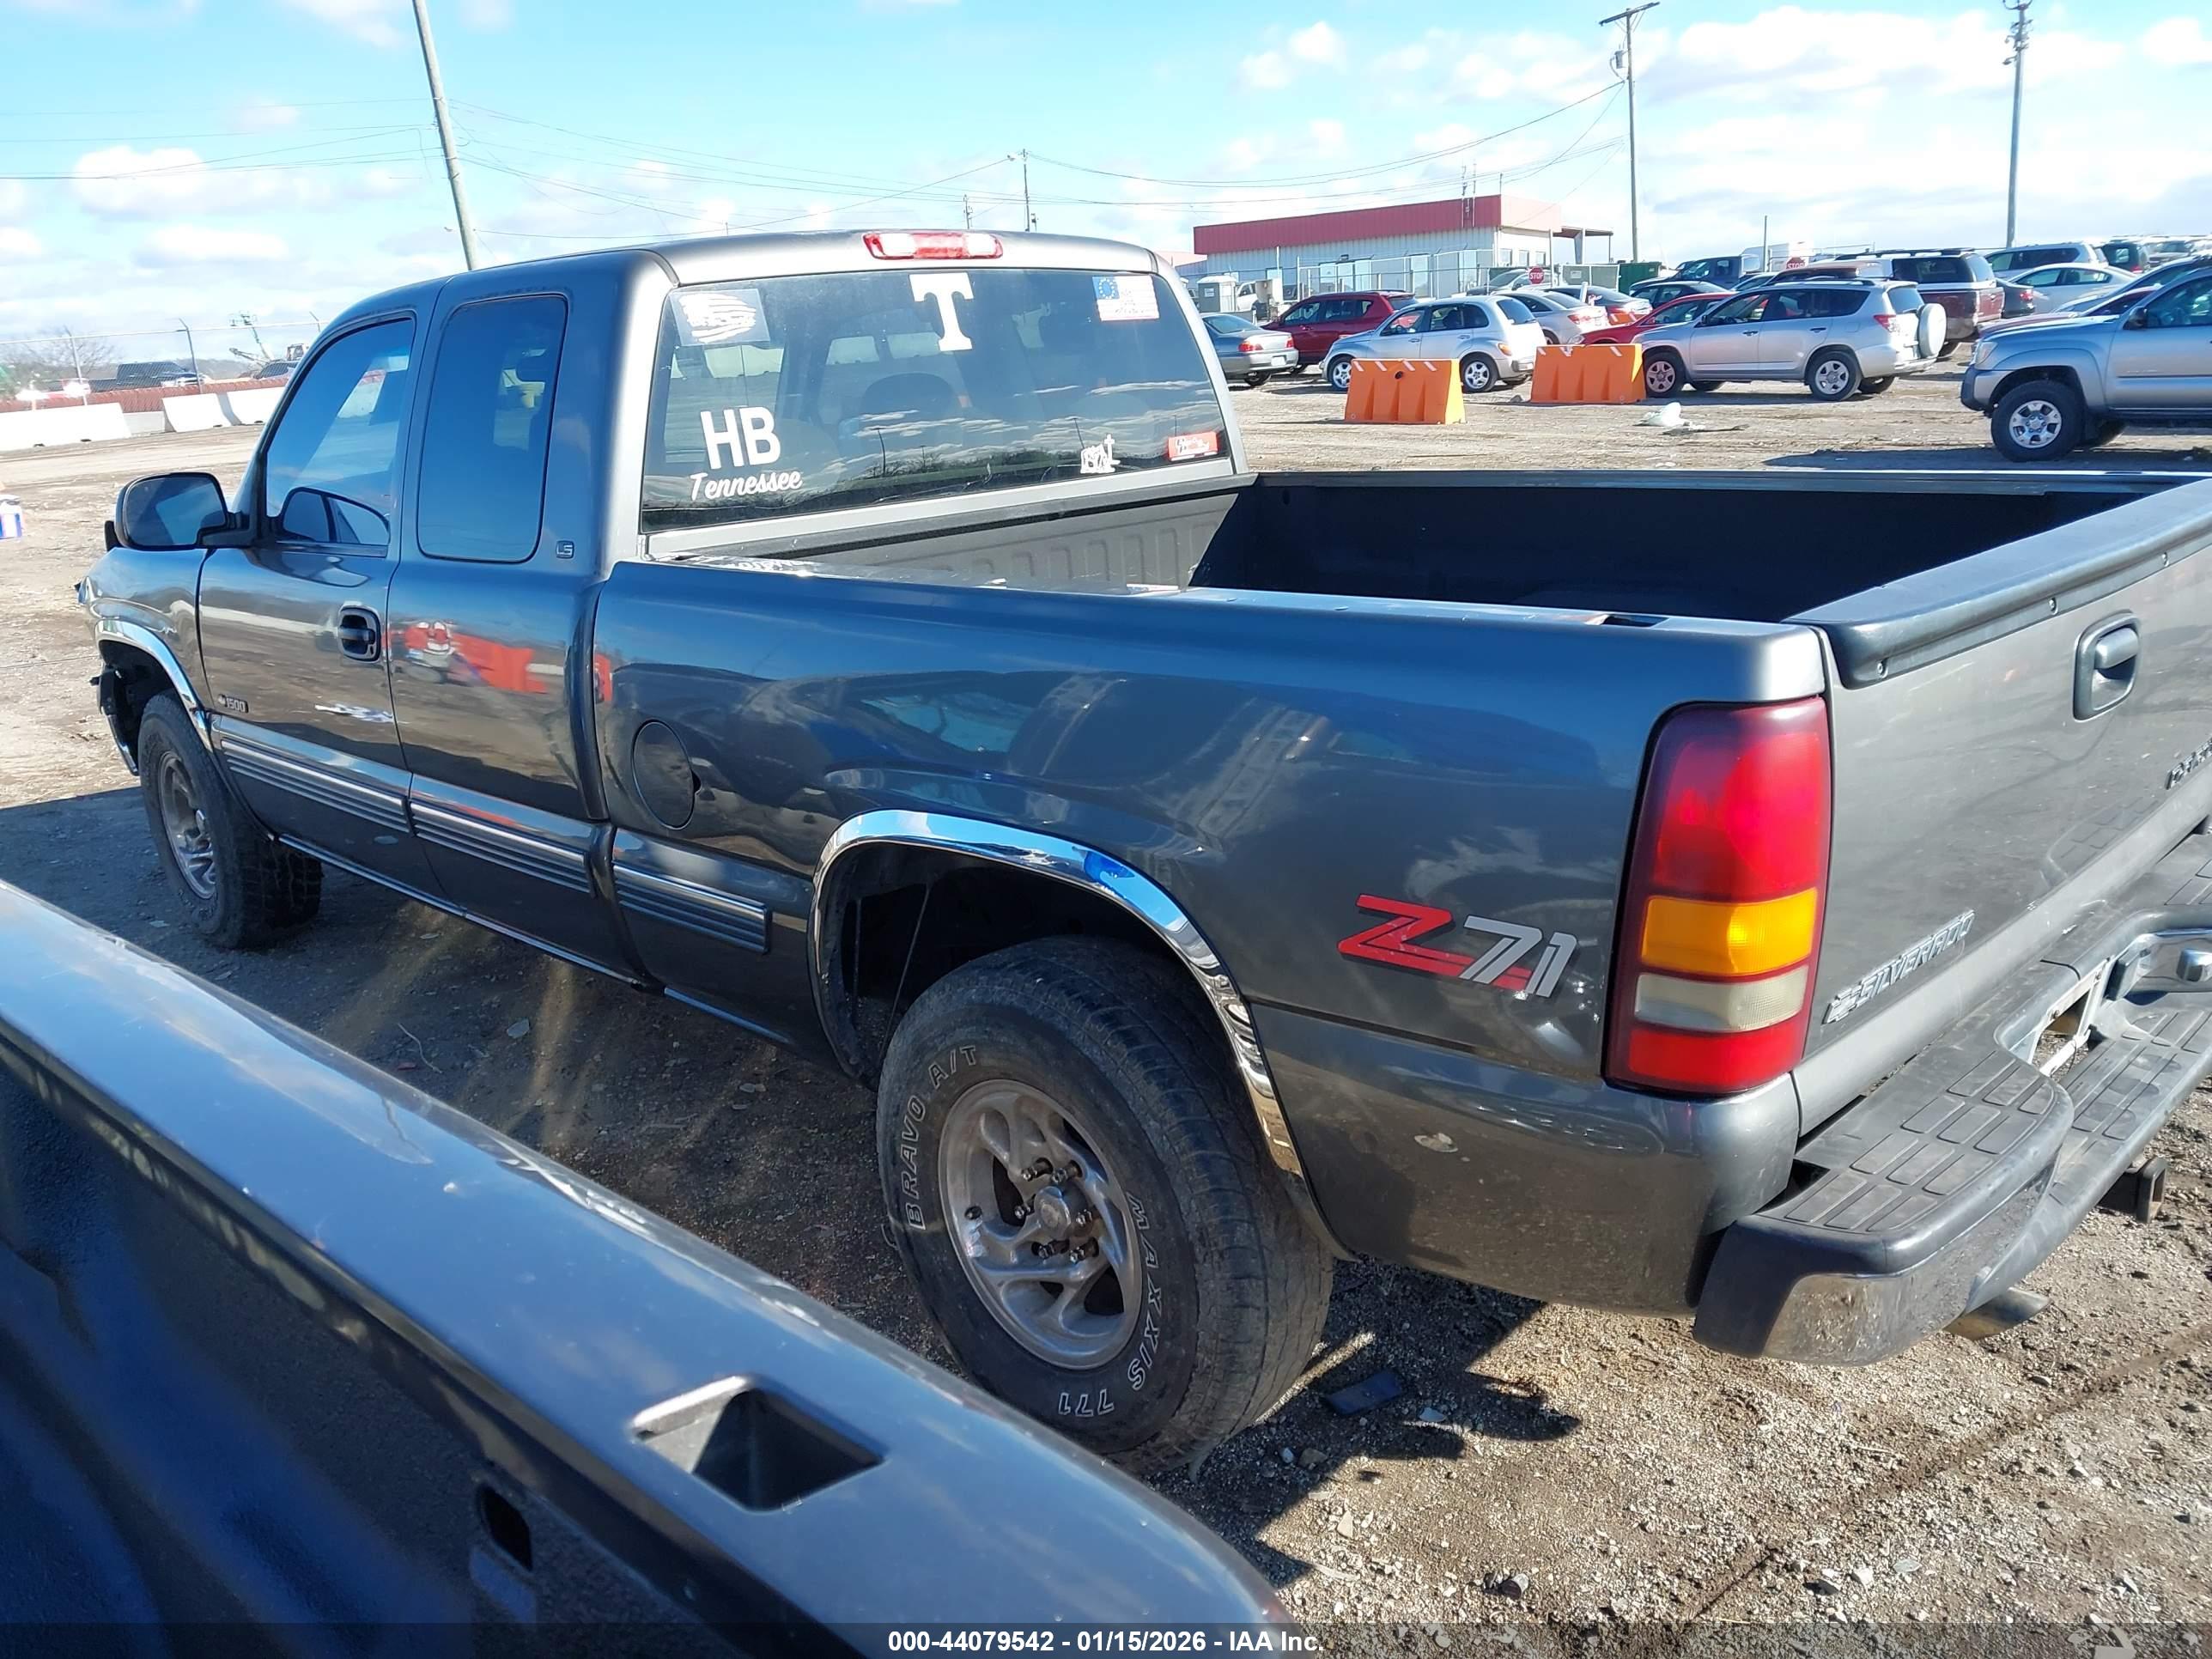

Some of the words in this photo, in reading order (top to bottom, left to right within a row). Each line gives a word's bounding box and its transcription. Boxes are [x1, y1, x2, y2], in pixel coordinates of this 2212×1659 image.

[908, 272, 975, 352] T
[690, 471, 803, 501] Tennessee
[700, 406, 781, 470] HB
[1338, 894, 1577, 999] Z71
[1856, 909, 1975, 1008] SILVERADO
[900, 1094, 926, 1231] BRAVO
[927, 1044, 976, 1090] A/T
[1125, 1191, 1162, 1391] MAXXIS
